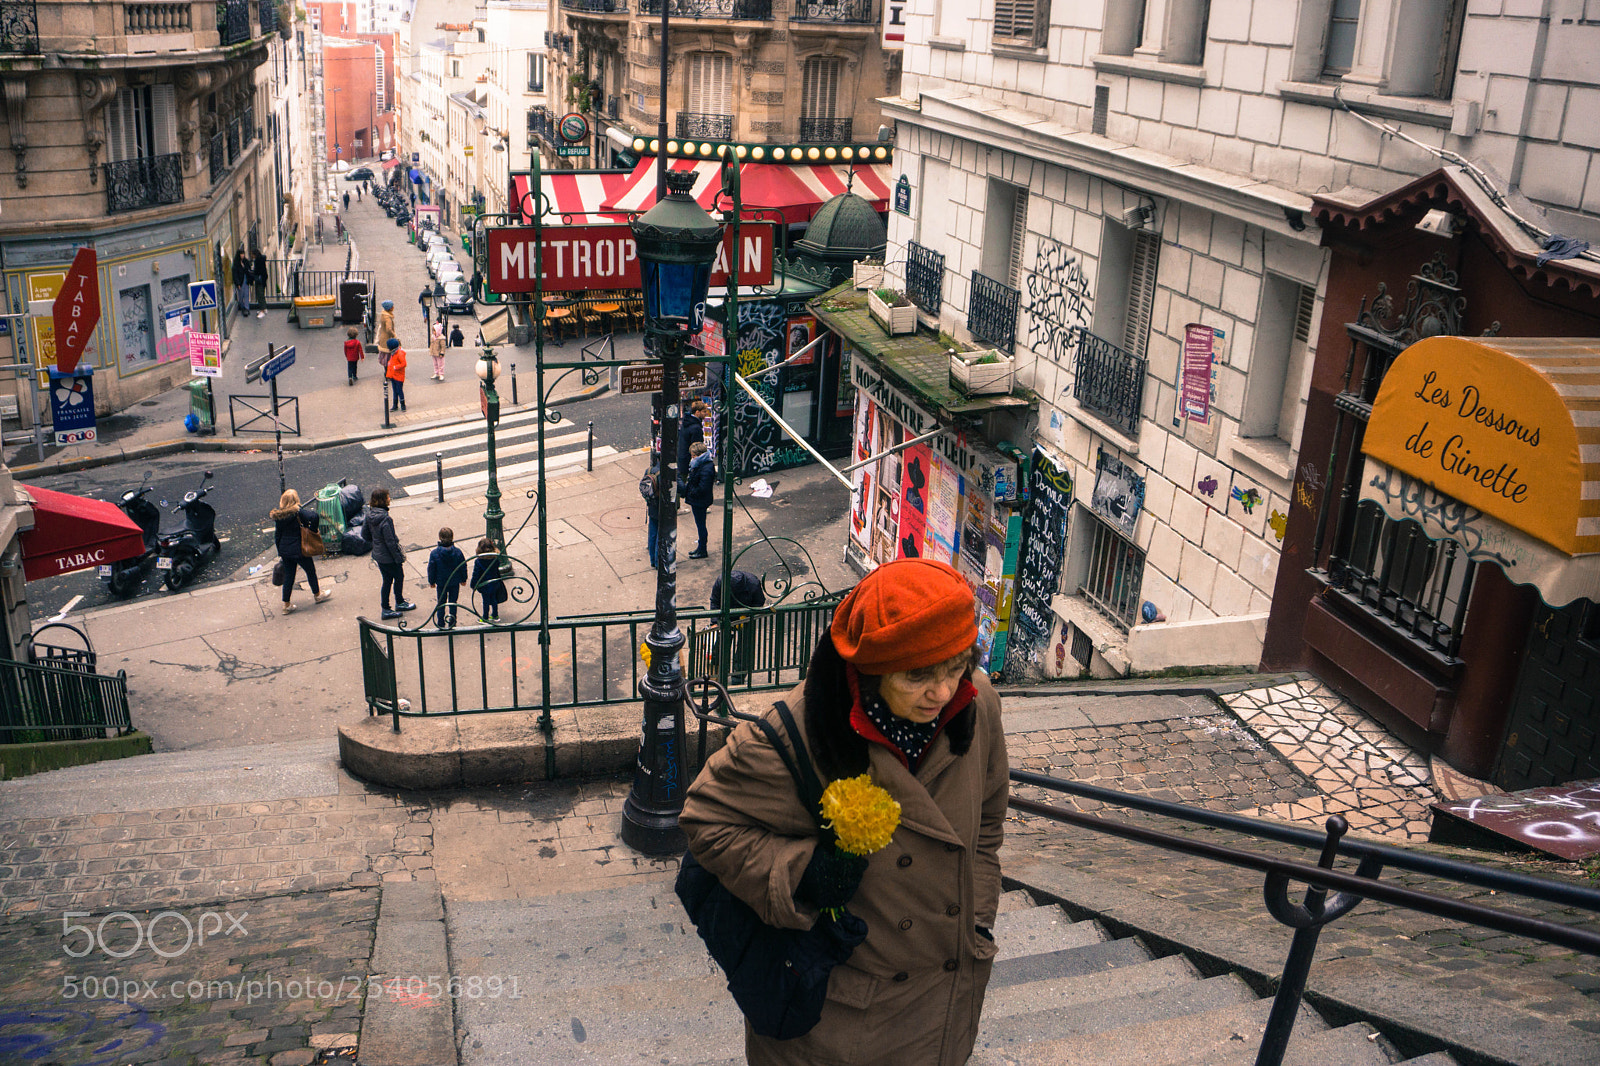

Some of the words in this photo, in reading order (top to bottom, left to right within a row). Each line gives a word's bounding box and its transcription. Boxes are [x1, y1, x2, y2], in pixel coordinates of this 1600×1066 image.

[559, 147, 567, 155] Le
[567, 147, 589, 155] REFUGE
[500, 236, 763, 280] METROPAN
[66, 274, 88, 347] TABAC
[57, 407, 90, 415] FRANÇAISE
[1414, 370, 1452, 409] Les
[1458, 385, 1542, 447] Dessous
[58, 430, 95, 443] LOTO
[1405, 422, 1433, 458] de
[1440, 434, 1528, 503] Ginette
[56, 549, 105, 570] TABAC
